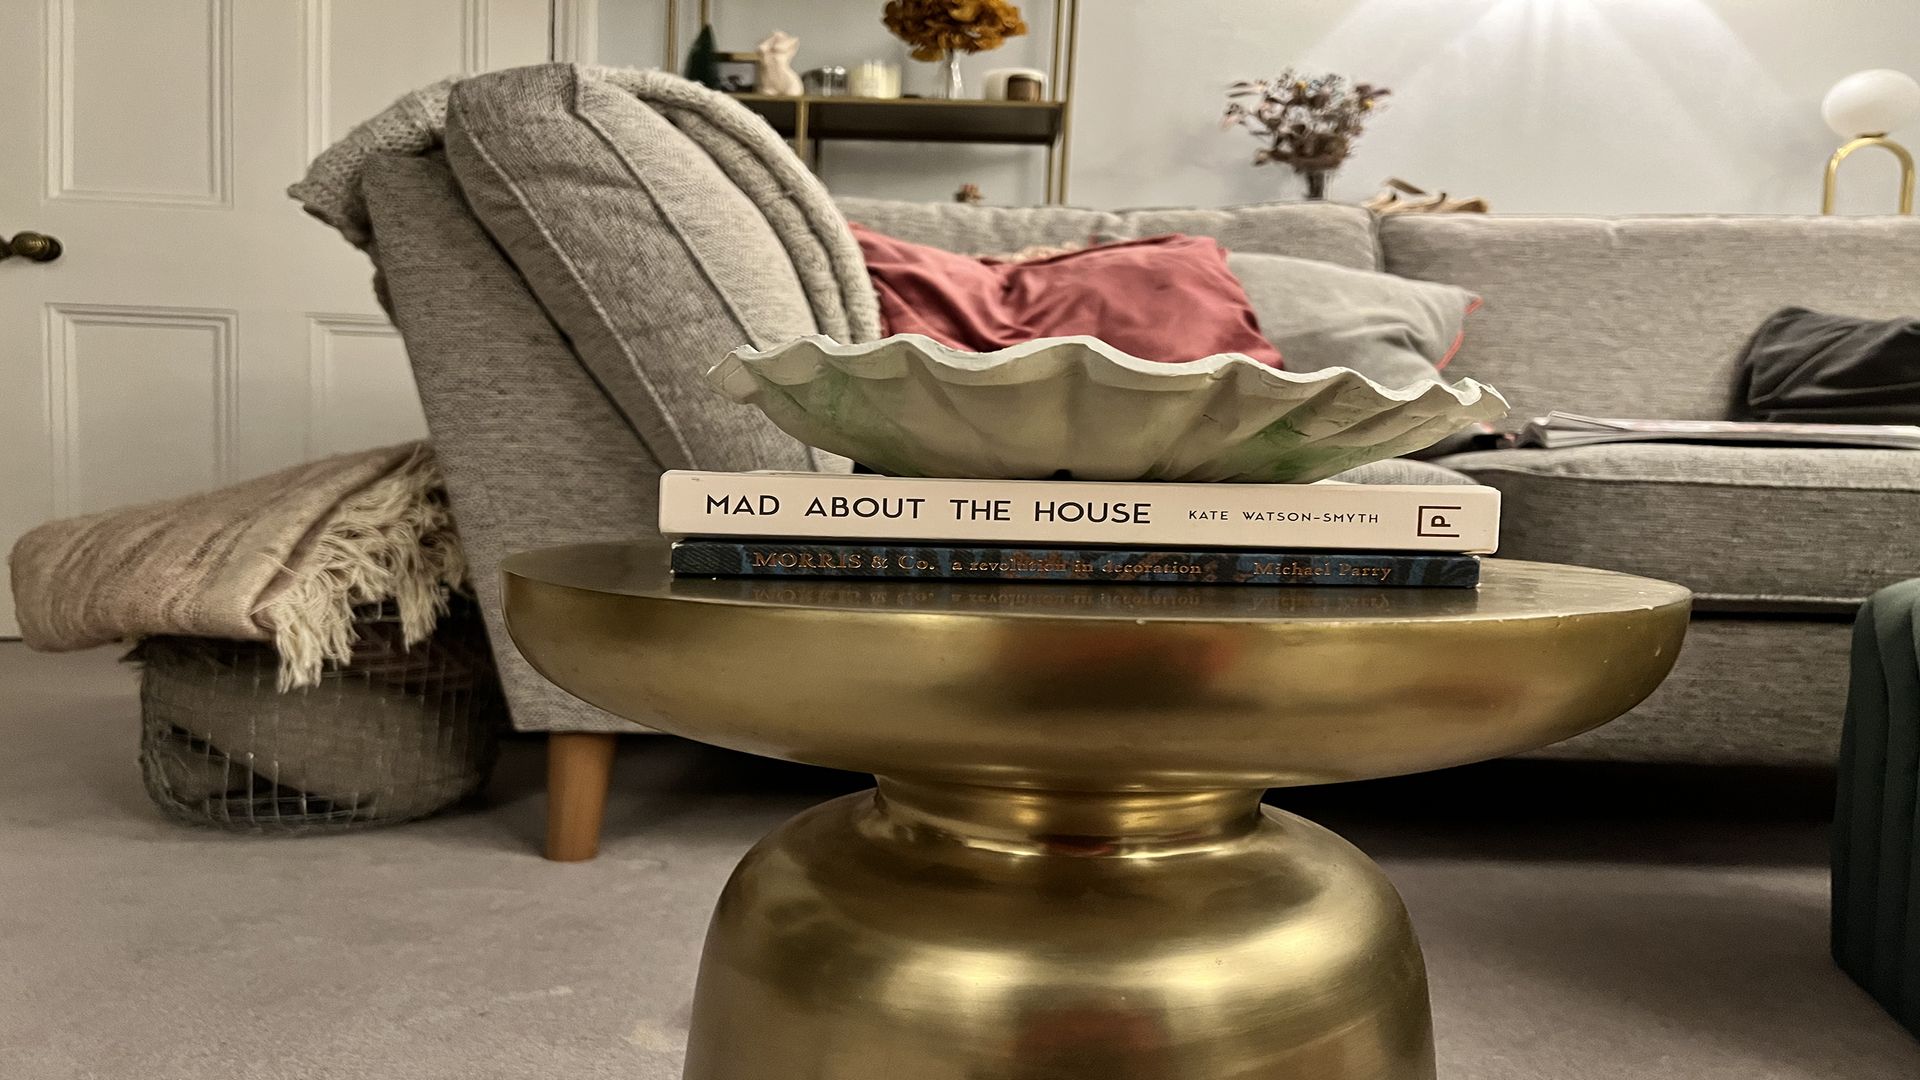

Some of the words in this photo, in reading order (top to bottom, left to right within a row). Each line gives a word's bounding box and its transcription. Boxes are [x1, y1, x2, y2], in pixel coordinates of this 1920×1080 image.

[706, 493, 780, 516] MAD
[804, 496, 926, 519] ABOUT
[949, 499, 1011, 521] THE
[1034, 501, 1152, 524] HOUSE
[1188, 510, 1230, 521] KATE
[1242, 511, 1379, 524] WATSON-SMYTH
[752, 551, 862, 570] MORRIS
[870, 555, 888, 569] &
[898, 554, 935, 570] Co.
[952, 559, 963, 571] a
[969, 558, 1067, 573] revolution
[1074, 559, 1095, 573] in
[1102, 559, 1202, 575] decoration
[1253, 561, 1332, 577] Michael
[1339, 562, 1392, 581] Parry
